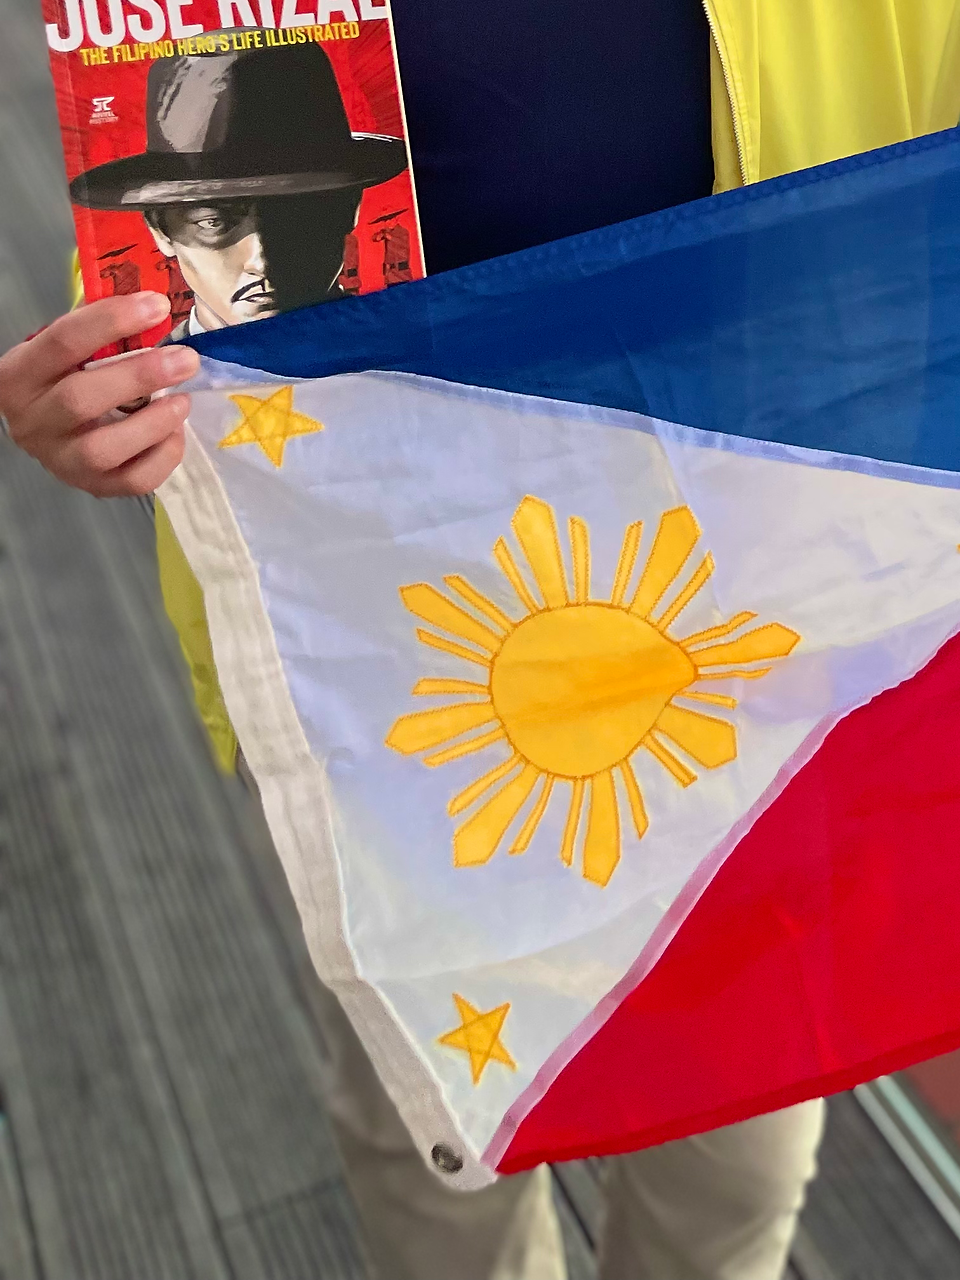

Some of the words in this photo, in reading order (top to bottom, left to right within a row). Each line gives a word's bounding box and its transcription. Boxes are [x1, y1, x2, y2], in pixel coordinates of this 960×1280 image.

[79, 46, 110, 67] THE
[112, 39, 175, 63] FILIPINO
[177, 34, 230, 56] HERO'S
[232, 30, 264, 51] LIFE
[265, 21, 360, 48] ILLUSTRATED
